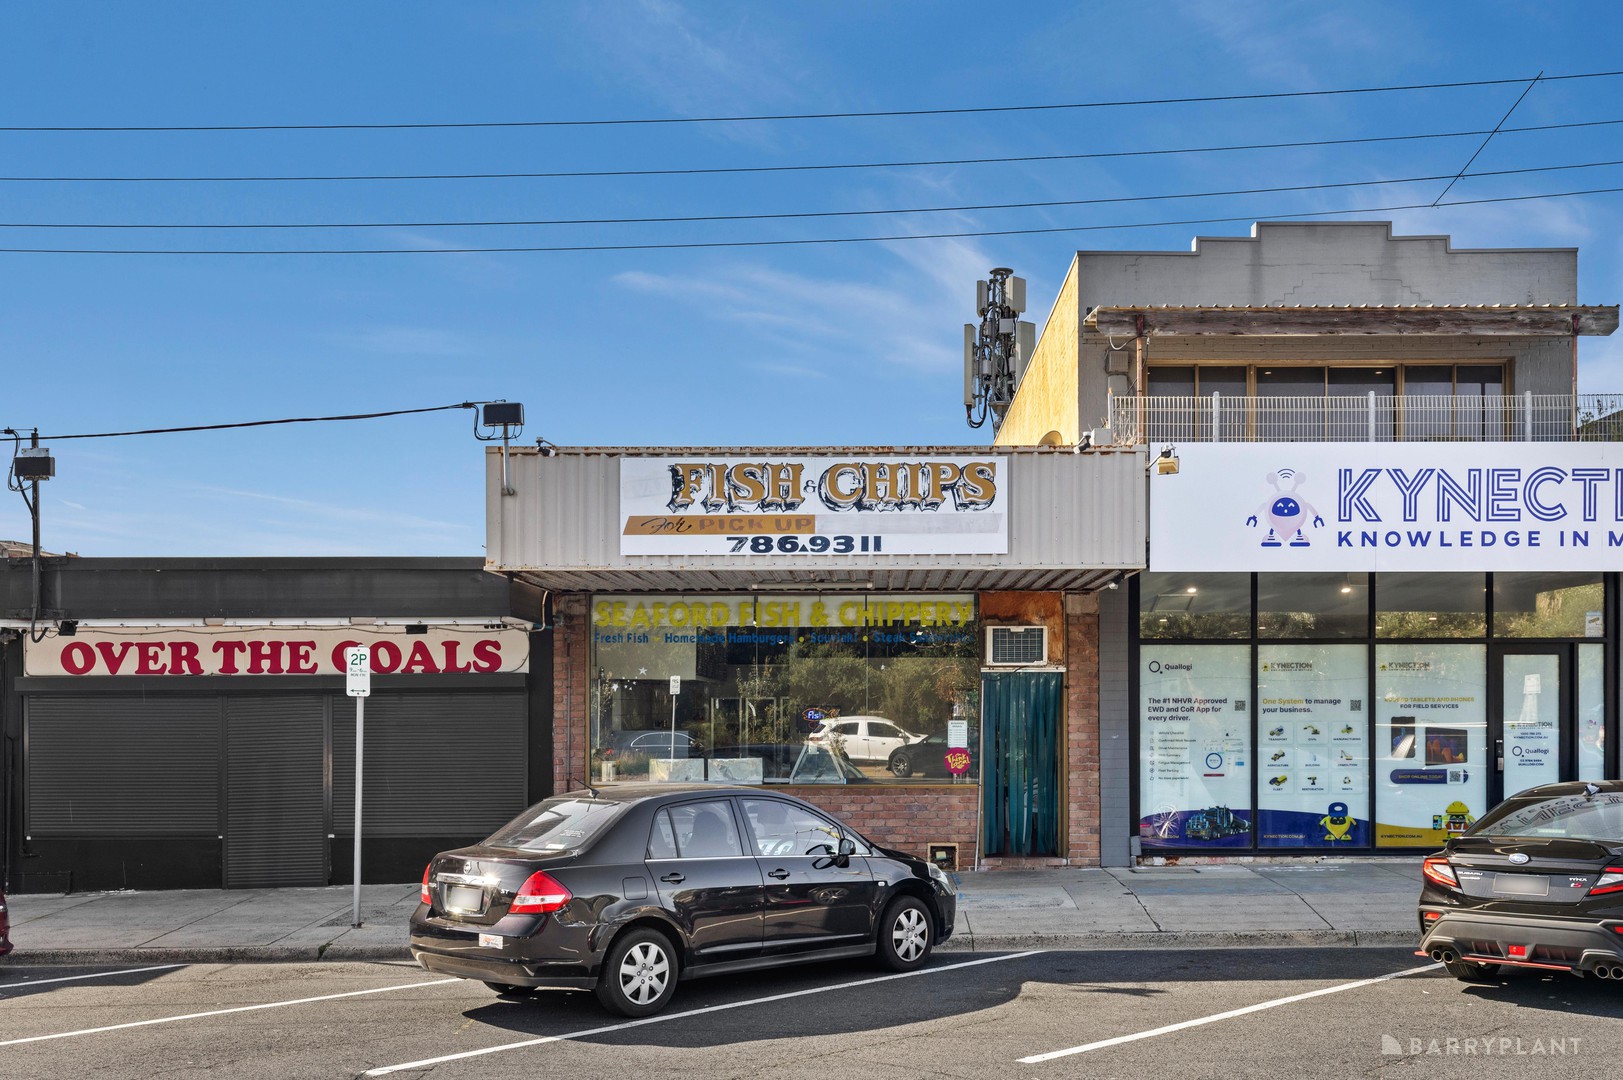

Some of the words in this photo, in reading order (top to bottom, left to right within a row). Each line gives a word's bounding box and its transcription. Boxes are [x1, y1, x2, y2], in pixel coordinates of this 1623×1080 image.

[667, 463, 805, 513] FISH
[803, 480, 817, 493] &
[818, 462, 997, 512] CHIPS
[700, 518, 764, 531] PICK
[775, 518, 812, 531] UP
[1338, 531, 1541, 547] KNOWLEDGE
[1560, 531, 1589, 547] IN
[595, 601, 730, 627] SEAFORD
[738, 601, 799, 627] FISH
[809, 601, 829, 627] &
[838, 601, 972, 628] CHIPPERY
[594, 632, 623, 643] Fresh
[627, 632, 649, 643] Fish
[664, 632, 726, 643] Homemade
[728, 632, 795, 645] Hamburgers
[874, 632, 904, 643] Steak
[60, 641, 205, 675] OVER
[212, 640, 318, 674] THE
[350, 653, 367, 666] 2P
[1164, 663, 1193, 671] Quallogi
[1194, 698, 1228, 706] Approved
[1278, 698, 1304, 706] System
[1196, 706, 1211, 714] App
